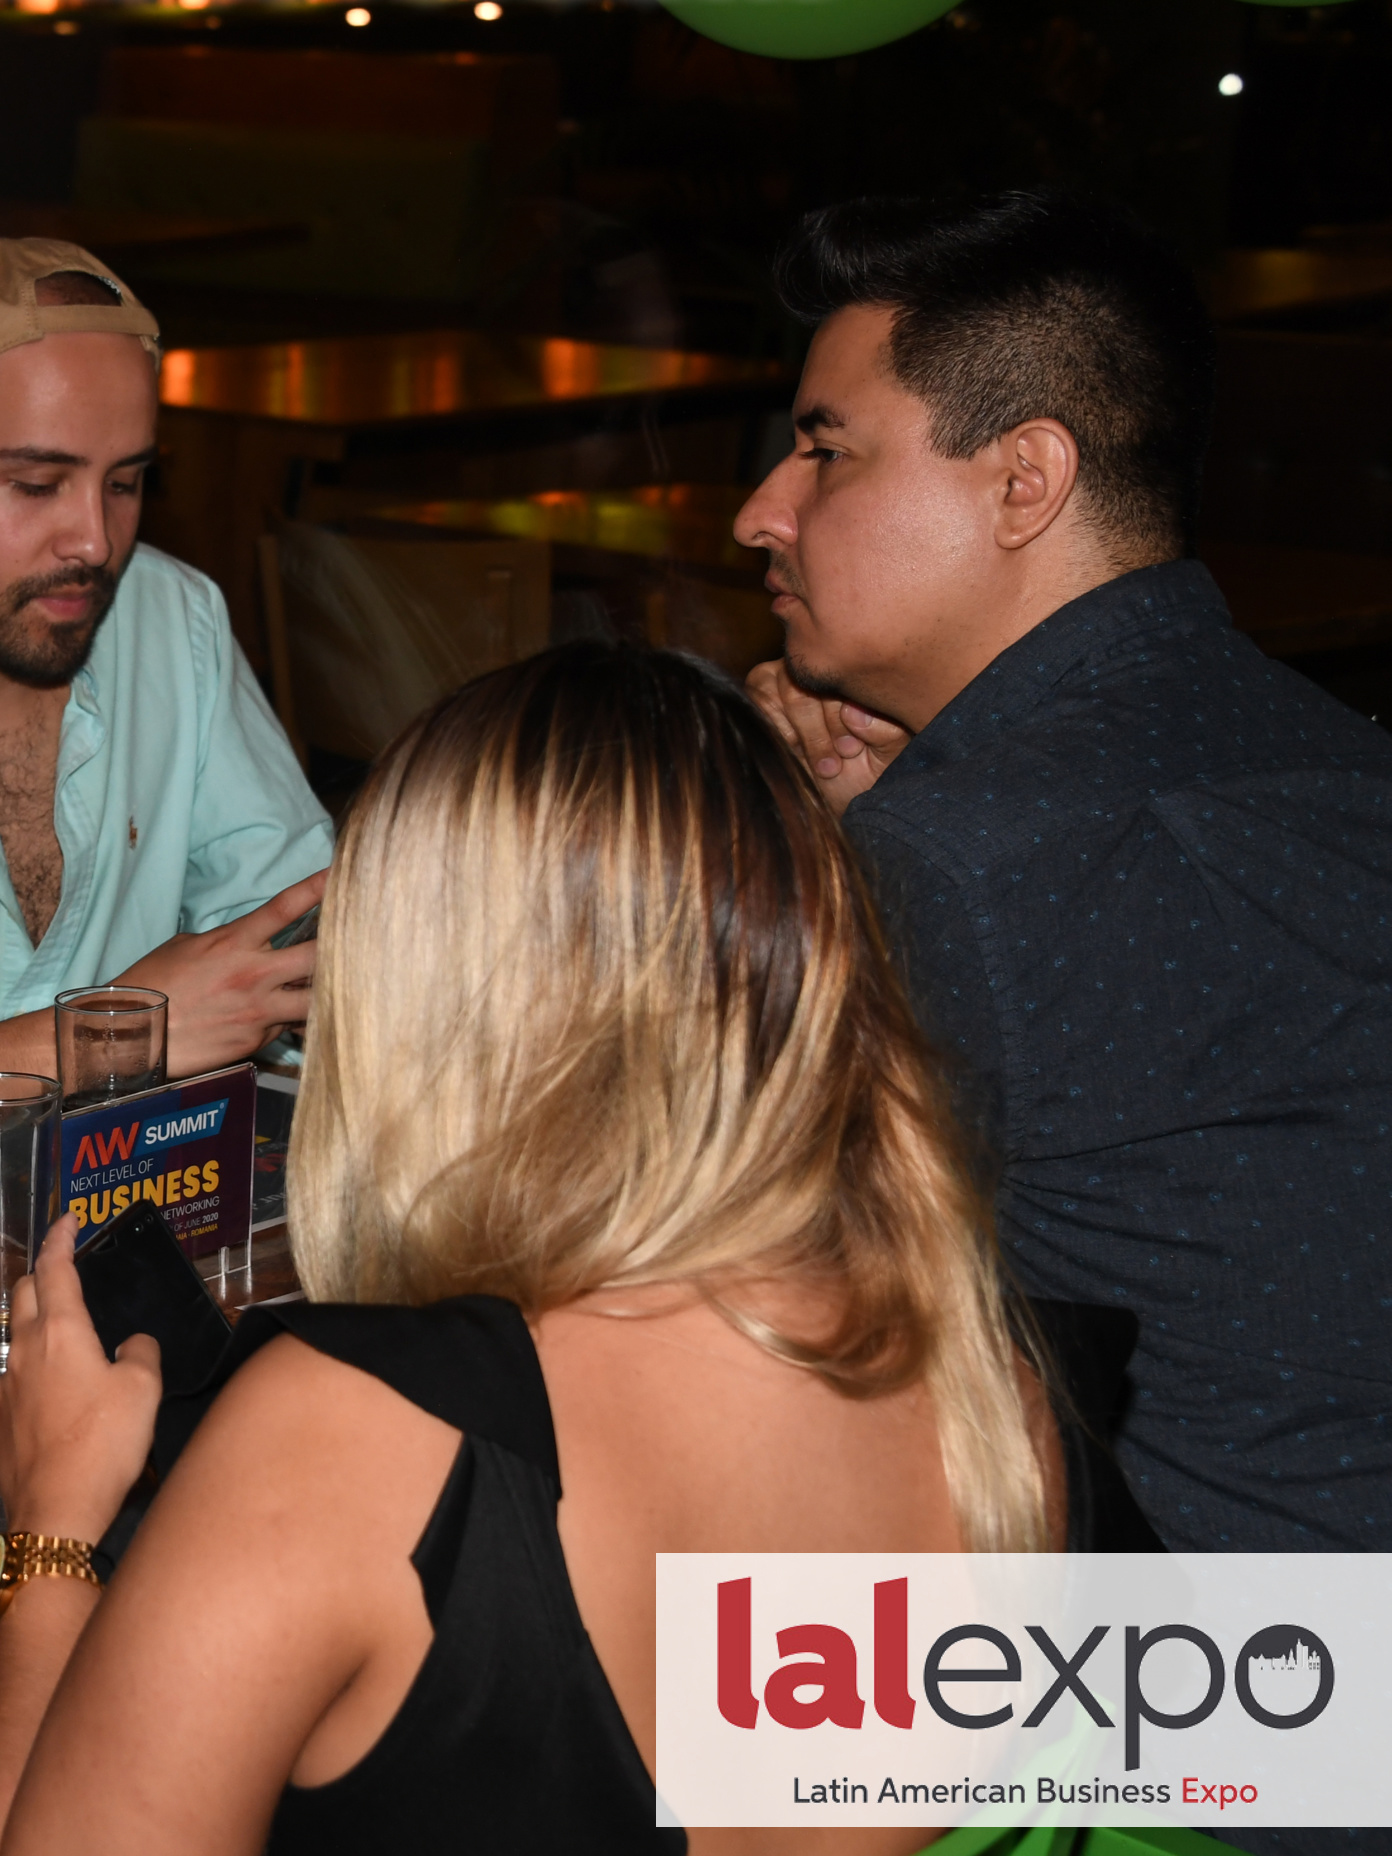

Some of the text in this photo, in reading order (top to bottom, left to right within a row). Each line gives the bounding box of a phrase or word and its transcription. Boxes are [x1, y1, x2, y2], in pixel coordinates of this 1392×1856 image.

[70, 1157, 154, 1194] NEXT LEVEL OF
[68, 1159, 220, 1230] BUSINESS
[183, 1216, 201, 1230] JUNE
[201, 1211, 219, 1224] 2020
